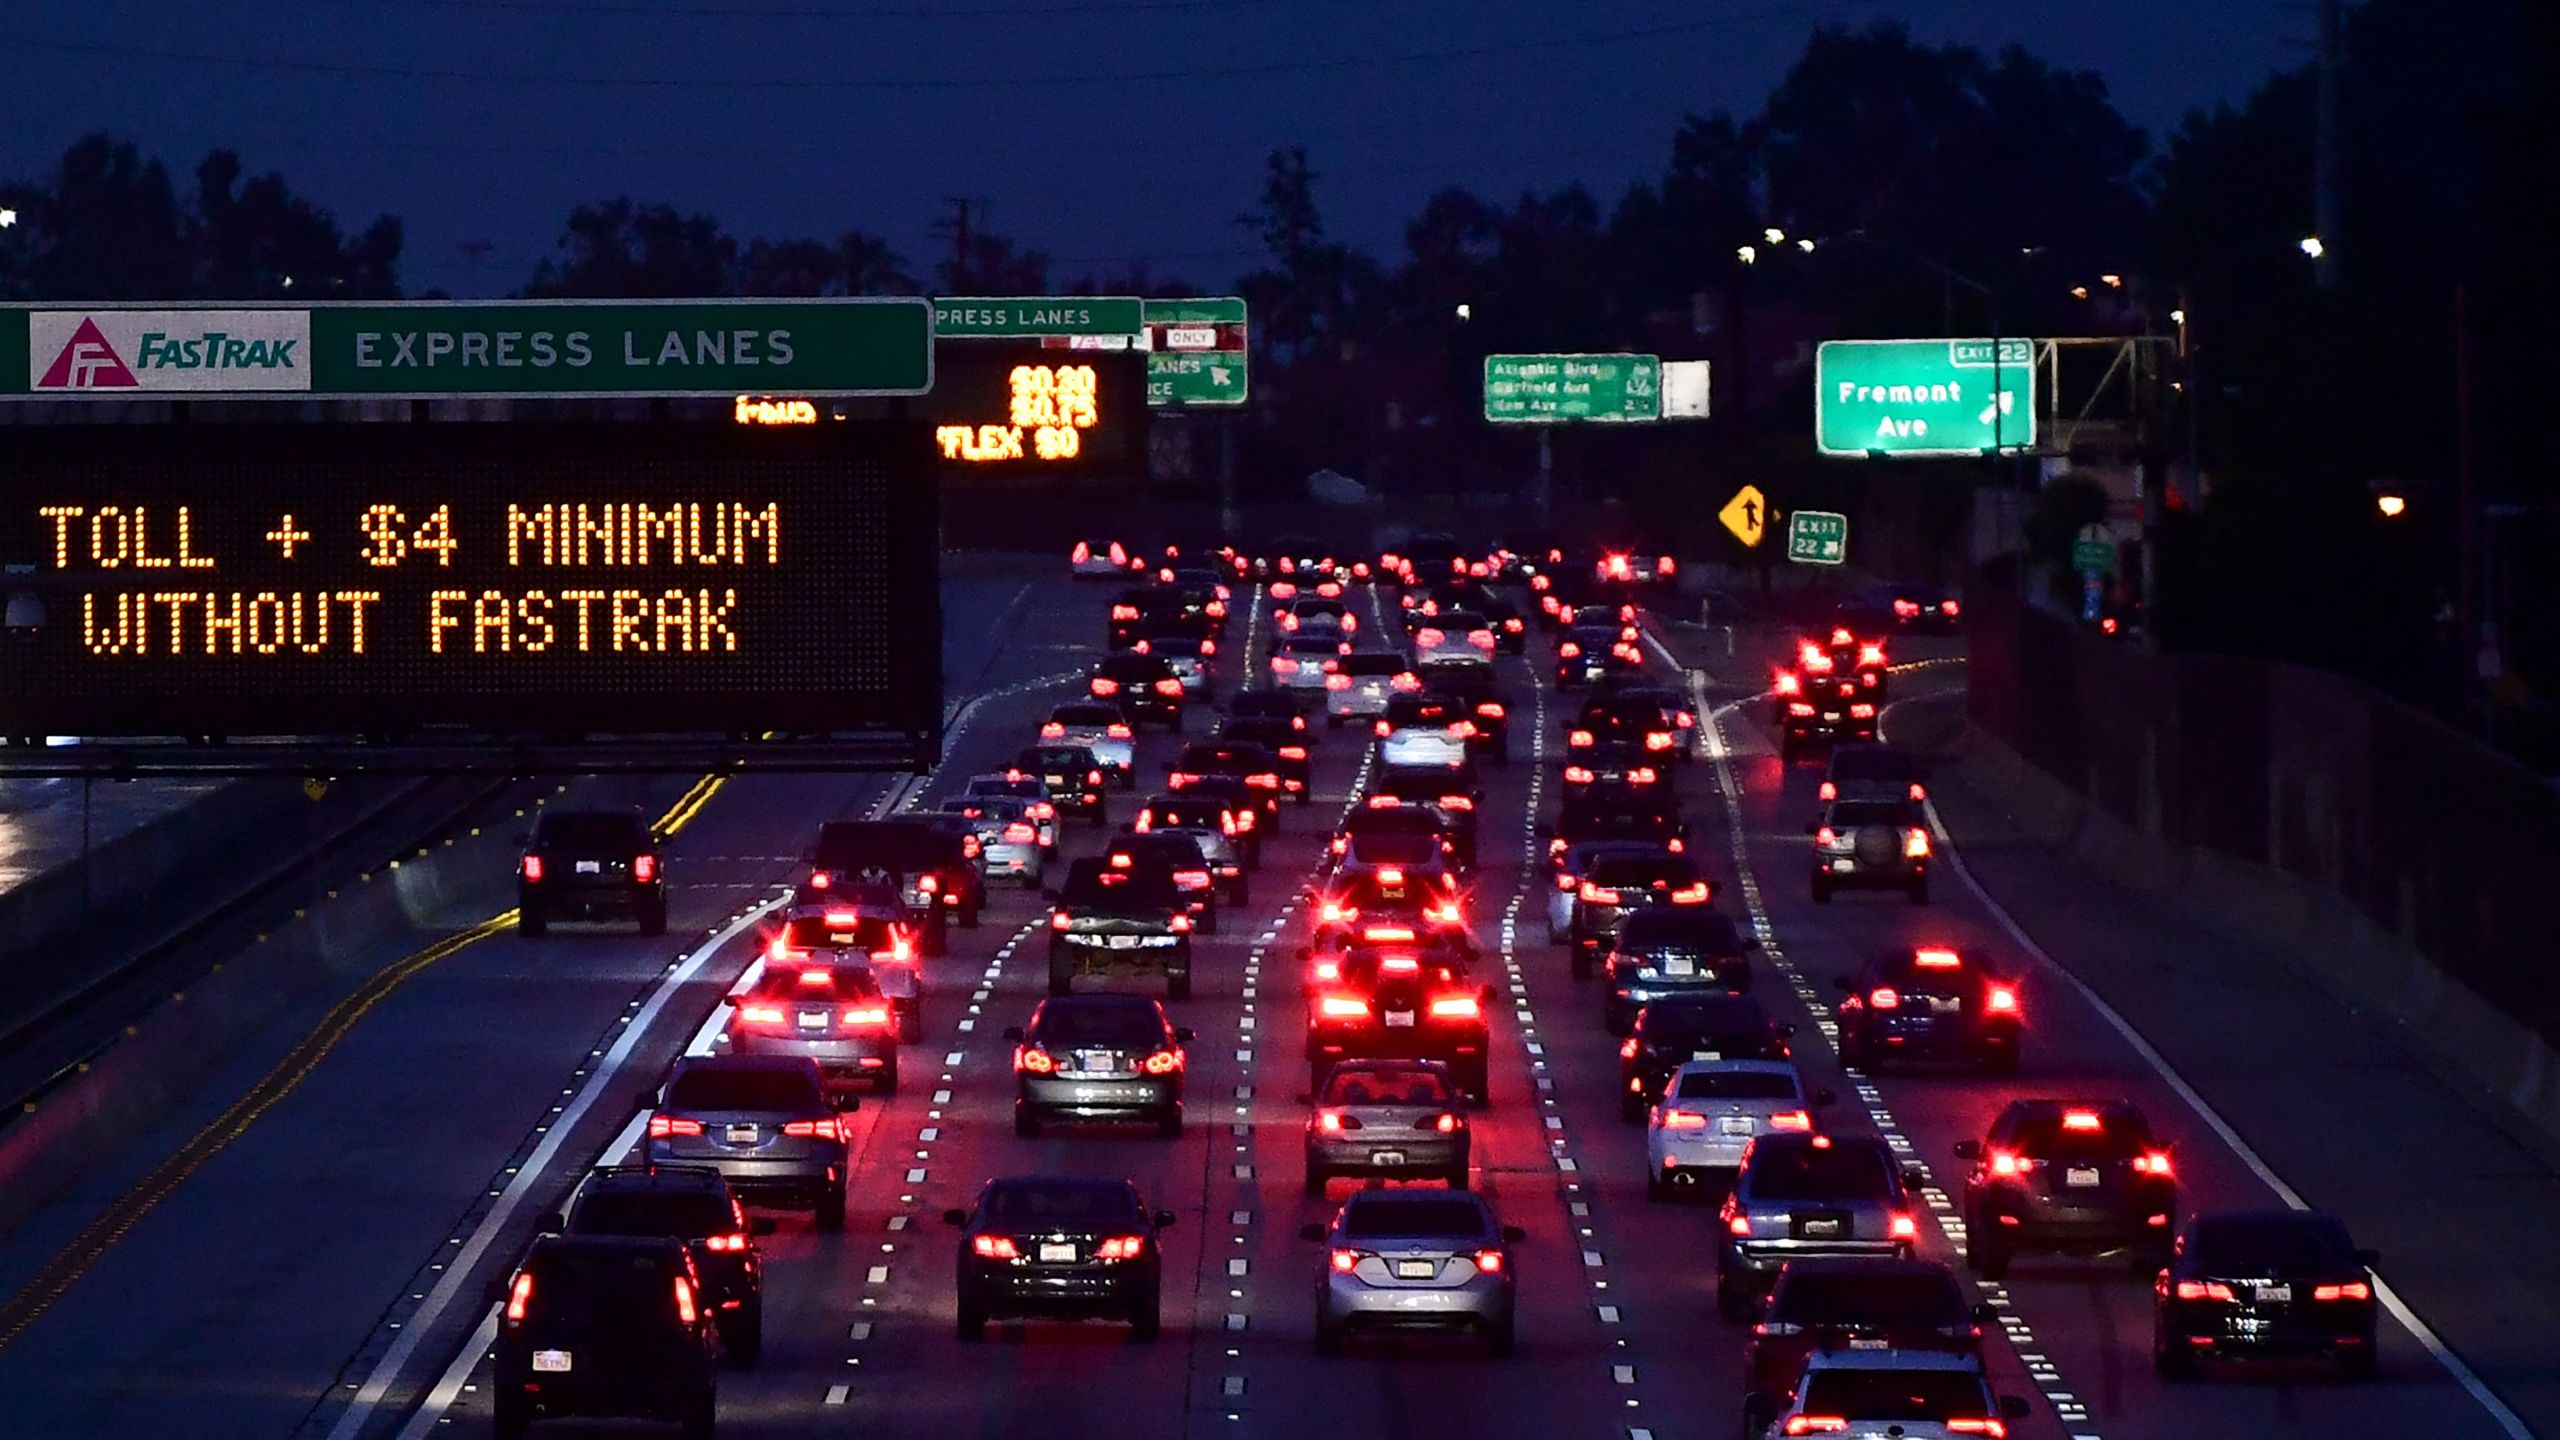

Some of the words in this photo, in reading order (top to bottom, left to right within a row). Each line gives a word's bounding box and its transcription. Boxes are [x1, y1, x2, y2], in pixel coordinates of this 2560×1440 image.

[1018, 309, 1091, 326] LANES
[356, 331, 593, 367] EXPRESS
[624, 329, 794, 366] LANES
[1173, 332, 1208, 344] ONLY
[1957, 345, 1995, 361] EXIT
[1998, 343, 2027, 361] 22
[1009, 365, 1097, 394] $0.30
[1839, 380, 1962, 404] Fremont
[1876, 415, 1928, 437] Ave
[1034, 425, 1079, 460] $0
[40, 506, 215, 568] TOLL
[360, 504, 458, 567] $4
[508, 502, 778, 566] MINIMUM
[1797, 519, 1837, 534] EXIT
[1795, 538, 1817, 554] 22
[84, 591, 381, 655] WITHOUT
[431, 588, 737, 653] FASTRAK
